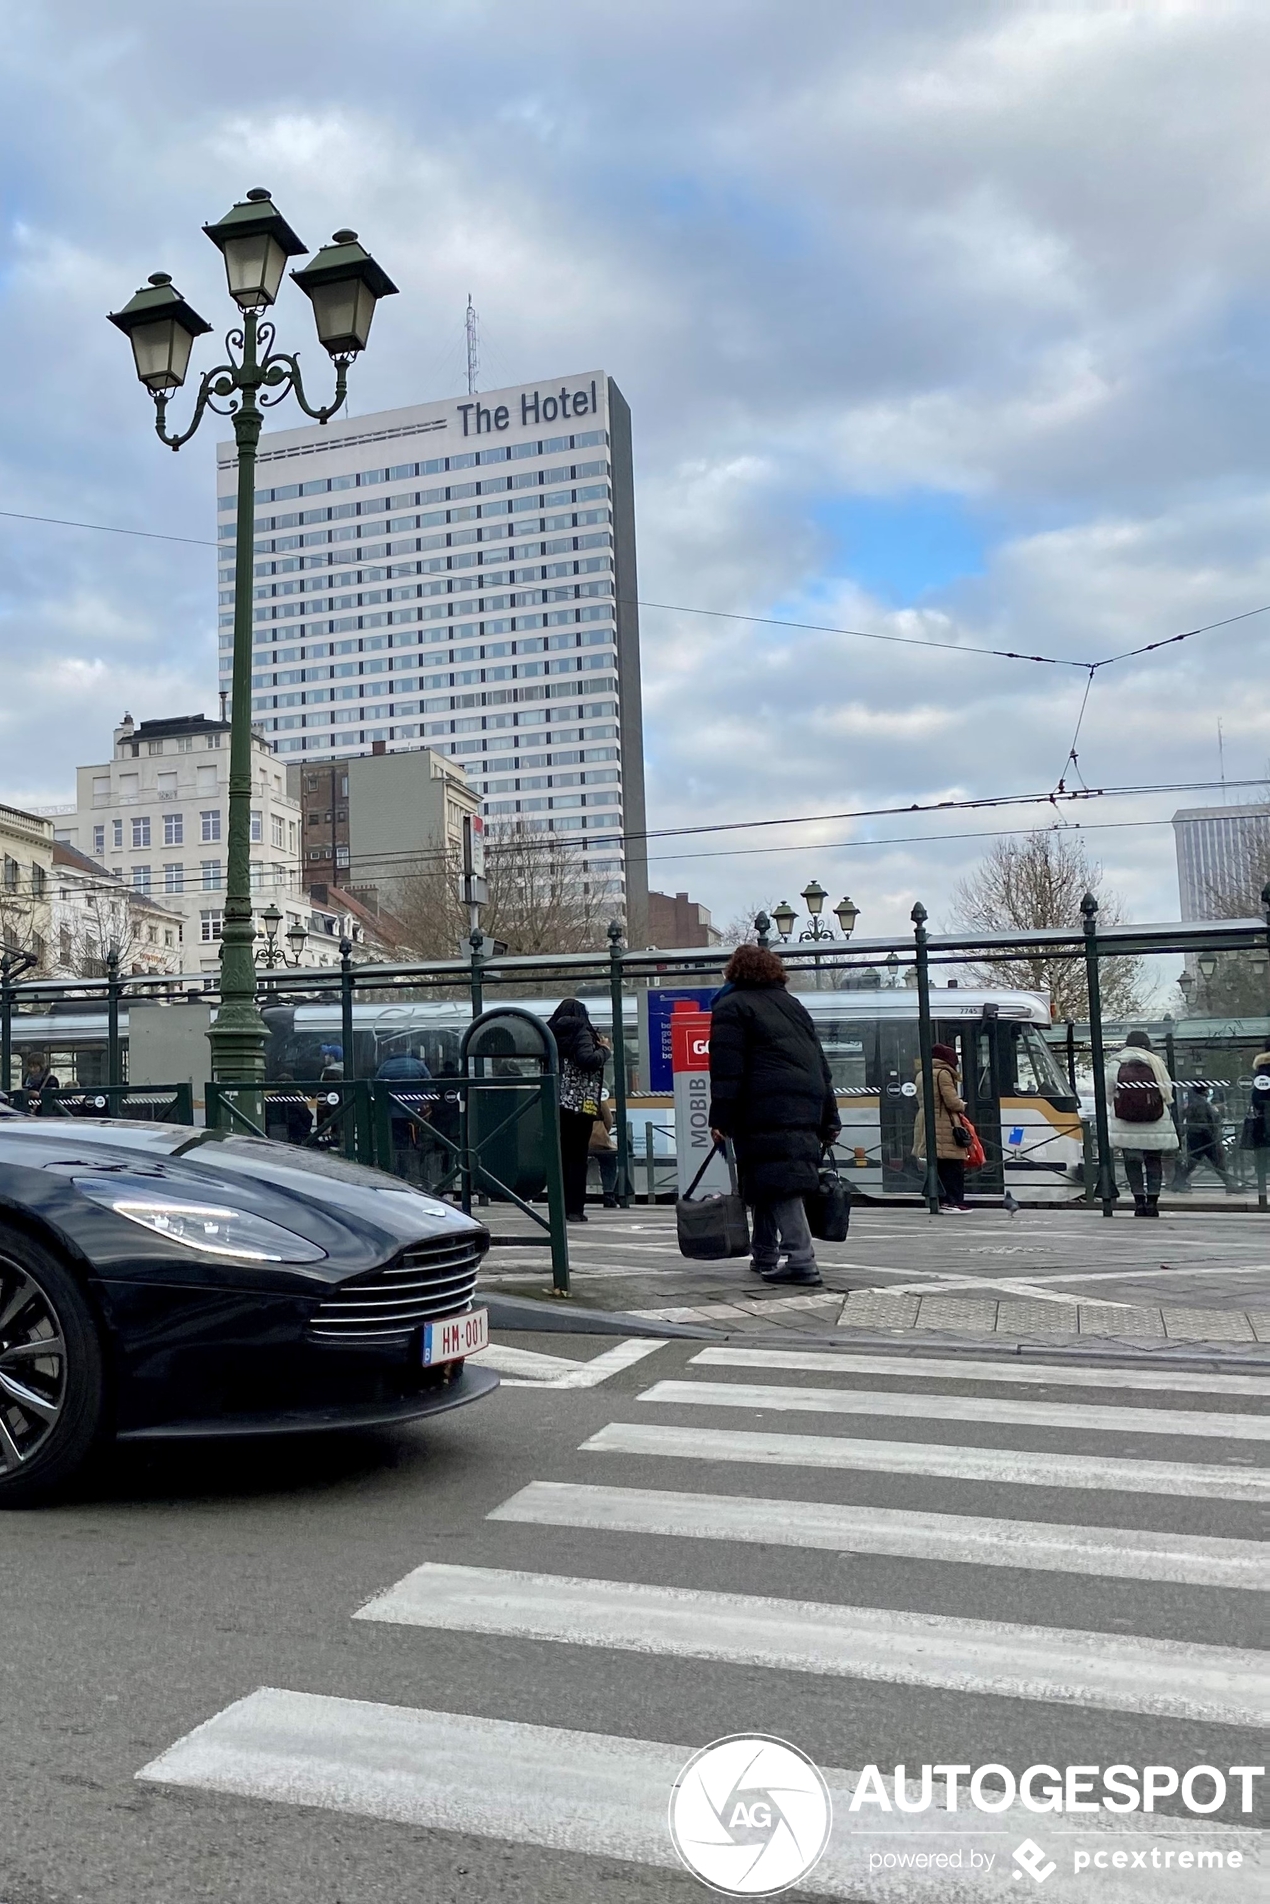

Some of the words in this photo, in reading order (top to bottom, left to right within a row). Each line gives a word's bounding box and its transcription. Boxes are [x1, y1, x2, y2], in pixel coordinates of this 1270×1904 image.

[457, 402, 509, 436] The
[521, 380, 597, 426] Hotel
[690, 1078, 708, 1148] MOBIB
